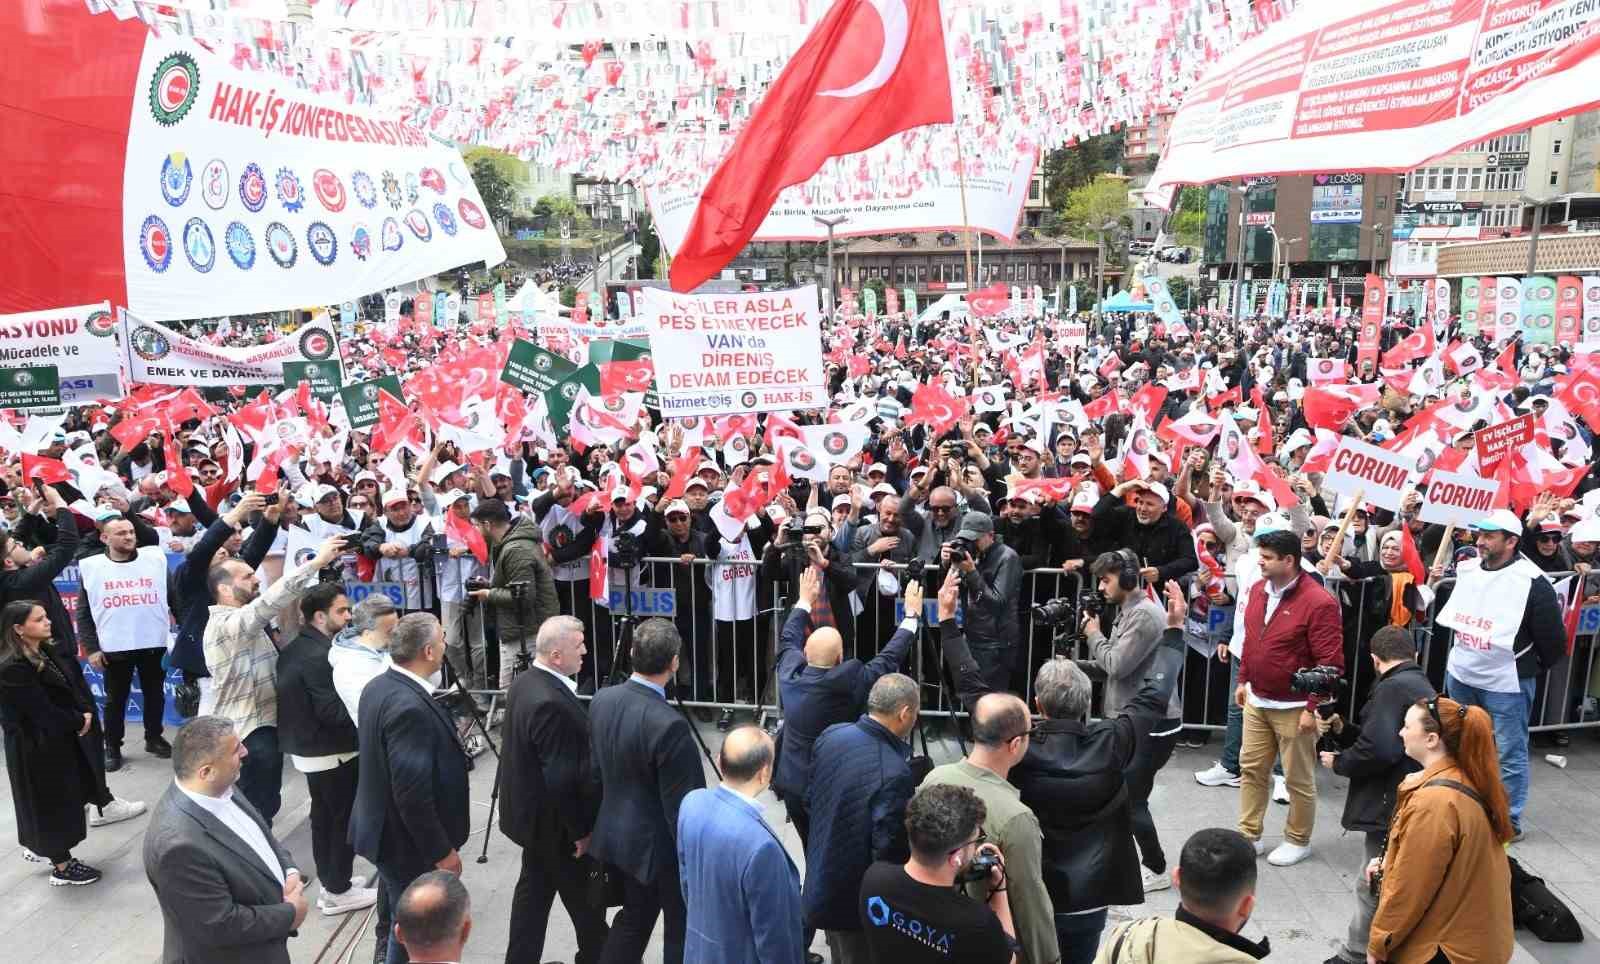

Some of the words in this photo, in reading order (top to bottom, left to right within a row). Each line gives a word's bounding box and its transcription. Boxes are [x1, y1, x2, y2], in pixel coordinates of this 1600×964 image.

[209, 81, 285, 139] HAK-İŞ
[744, 298, 793, 313] ASLA
[659, 315, 696, 330] PES
[707, 334, 766, 349] VAN'da
[0, 345, 59, 360] Mücadele
[63, 345, 79, 356] ve
[702, 351, 775, 370] DİRENİŞ
[147, 366, 185, 377] EMEK
[190, 369, 209, 378] VE
[670, 372, 730, 388] DEVAM
[736, 368, 809, 385] EDECEK
[663, 396, 706, 409] hizmet
[721, 395, 732, 408] iş
[764, 391, 813, 405] HAK-İŞ
[1335, 448, 1409, 490] ÇORUM
[1429, 480, 1494, 511] ÇORUM
[104, 577, 153, 590] HAK-İŞ
[103, 590, 159, 608] GÖREVLİ
[892, 912, 950, 949] GOYA
